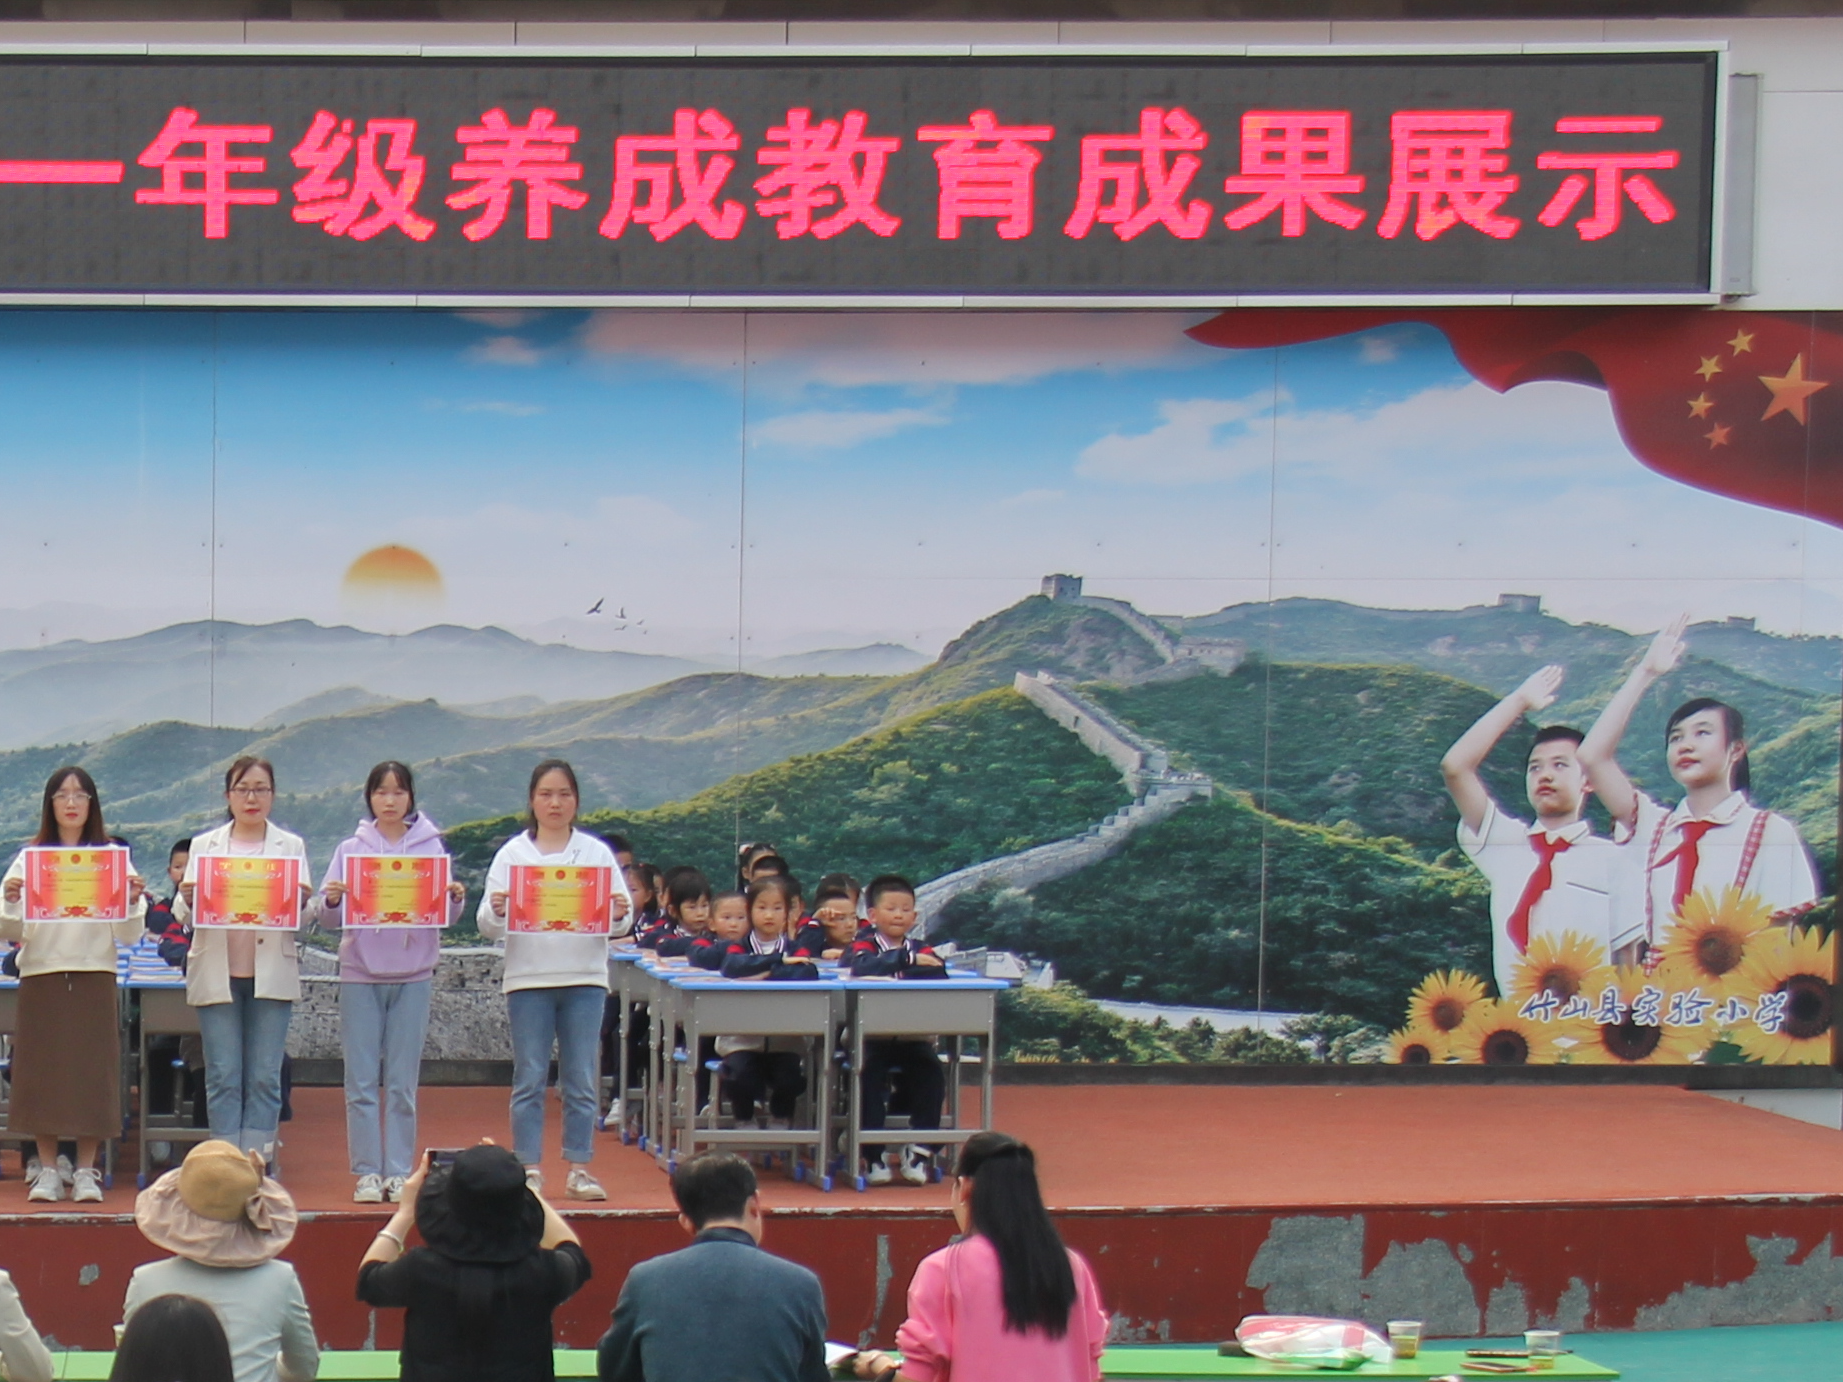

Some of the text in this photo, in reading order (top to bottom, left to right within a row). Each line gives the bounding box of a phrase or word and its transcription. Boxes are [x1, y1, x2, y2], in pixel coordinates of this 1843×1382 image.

[1518, 986, 1790, 1034] 竹山县实验小学
